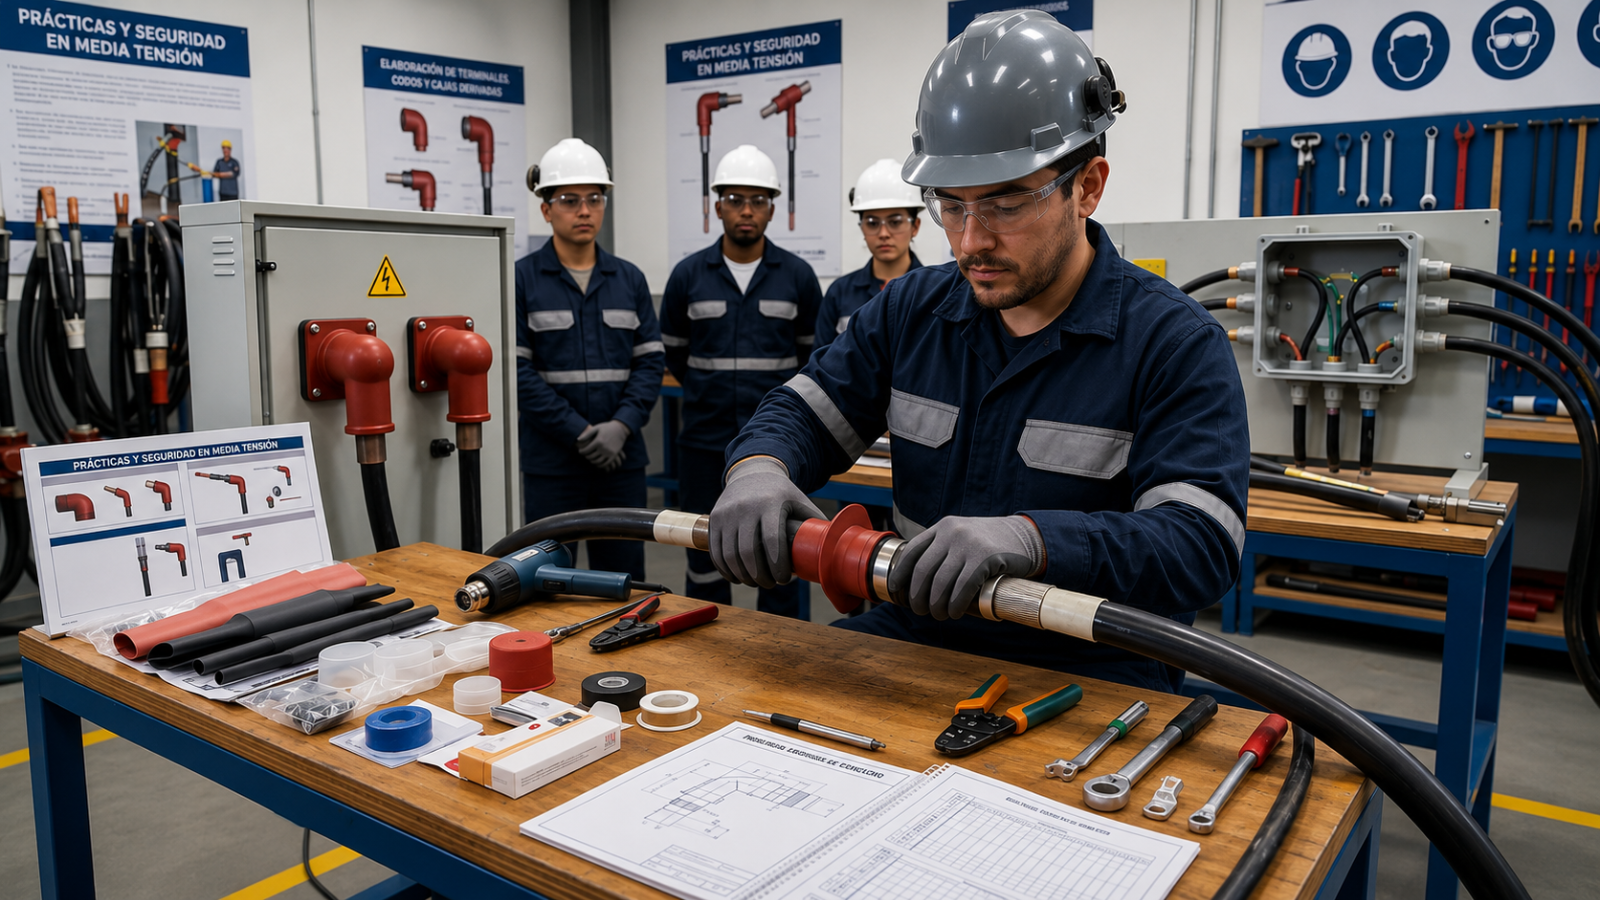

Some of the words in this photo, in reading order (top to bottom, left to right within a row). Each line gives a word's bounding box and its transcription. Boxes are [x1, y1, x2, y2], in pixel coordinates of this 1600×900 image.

[18, 8, 116, 36] PRÁCTICAS
[119, 22, 131, 37] Y
[135, 24, 226, 50] SEGURIDAD
[46, 33, 71, 51] EN
[75, 37, 130, 58] MEDIA
[133, 44, 203, 67] TENSIÓN
[682, 43, 742, 62] PRÁCTICAS
[743, 41, 751, 54] Y
[753, 32, 821, 52] SEGURIDAD
[380, 57, 443, 76] ELABORACIÓN
[445, 66, 457, 78] DE
[697, 63, 712, 76] EN
[714, 58, 750, 75] MEDIA
[752, 50, 804, 69] TENSIÓN
[391, 74, 423, 88] CODOS
[423, 78, 430, 89] Y
[431, 79, 458, 93] CAJAS
[459, 82, 503, 97] DERIVADAS
[73, 456, 131, 471] PRÁCTICAS
[132, 455, 139, 464] Y
[142, 449, 196, 463] SEGURIDAD
[198, 448, 210, 457] EN
[212, 444, 240, 455] MEDIA
[241, 438, 278, 452] TENSIÓN
